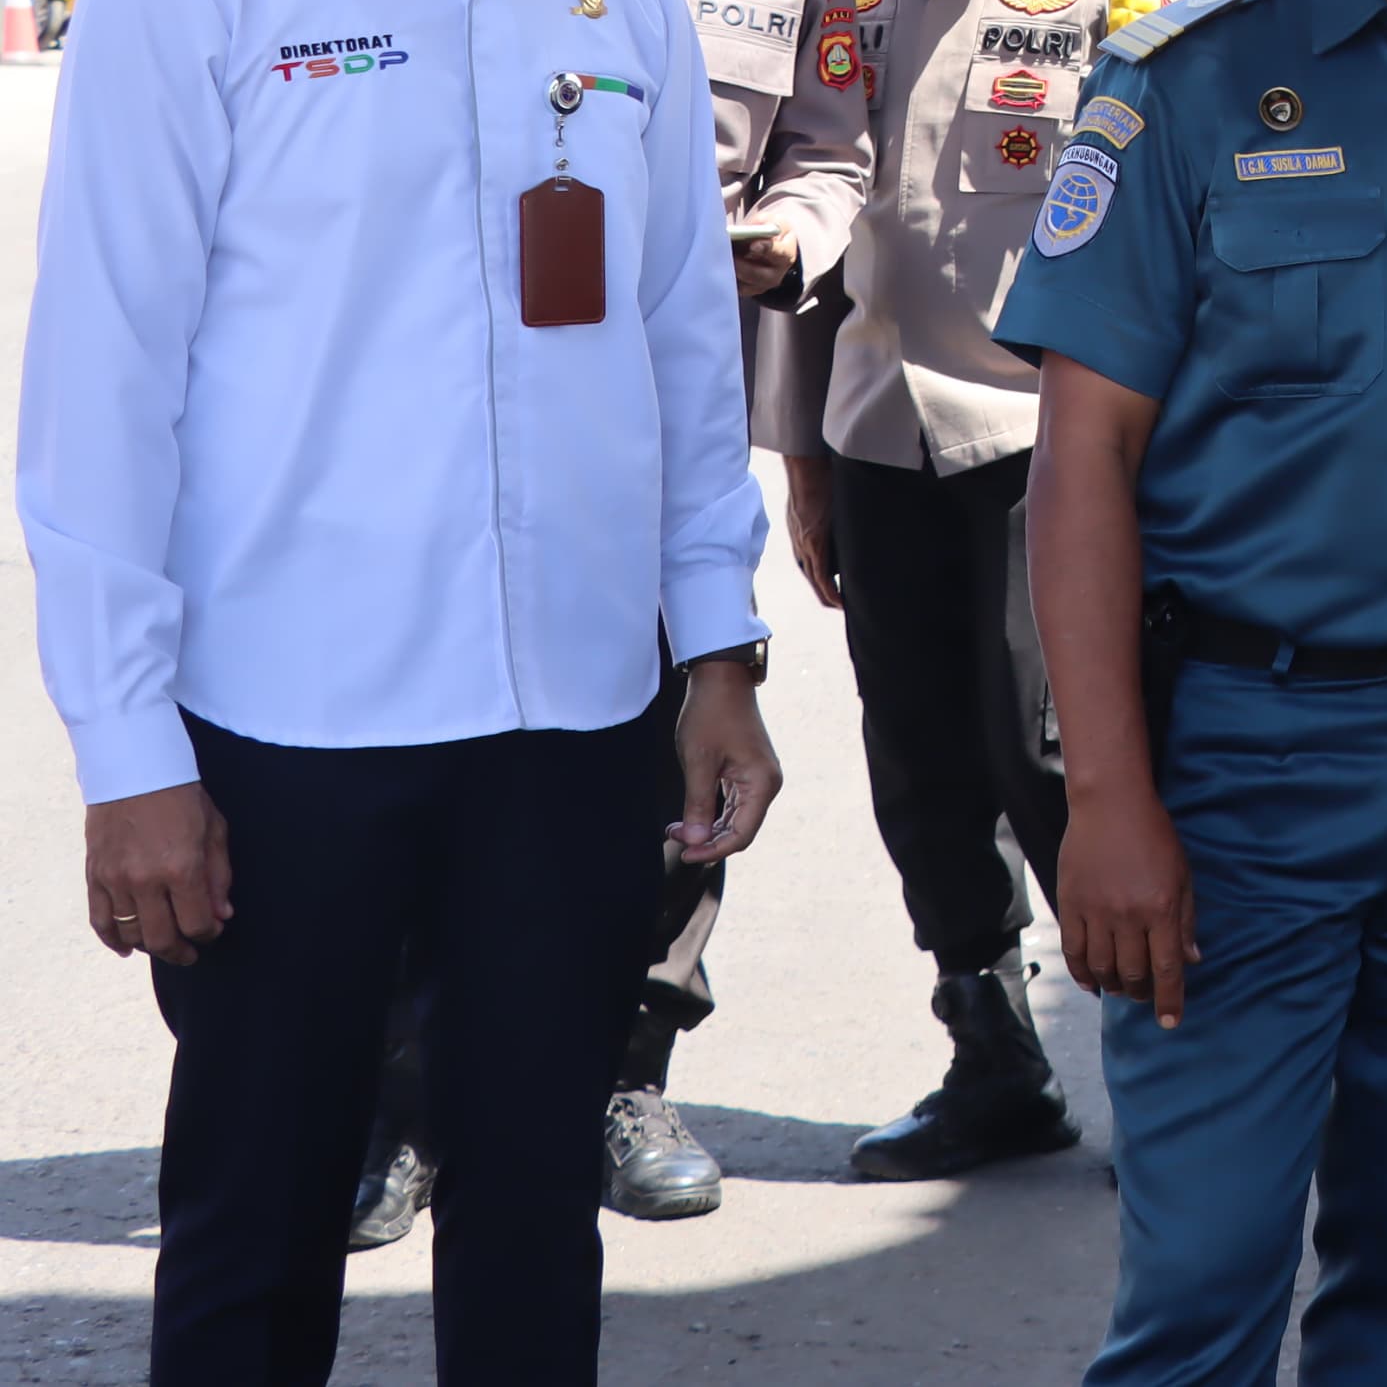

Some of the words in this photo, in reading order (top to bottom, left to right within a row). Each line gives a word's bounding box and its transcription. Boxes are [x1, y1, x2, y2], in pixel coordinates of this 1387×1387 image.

[697, 0, 796, 38] POLRI
[280, 34, 393, 60] DIREKTORAT
[983, 25, 1074, 59] POLRI
[271, 51, 409, 82] TSDP
[1271, 157, 1303, 172] SUSILA
[1305, 153, 1338, 170] DARMA
